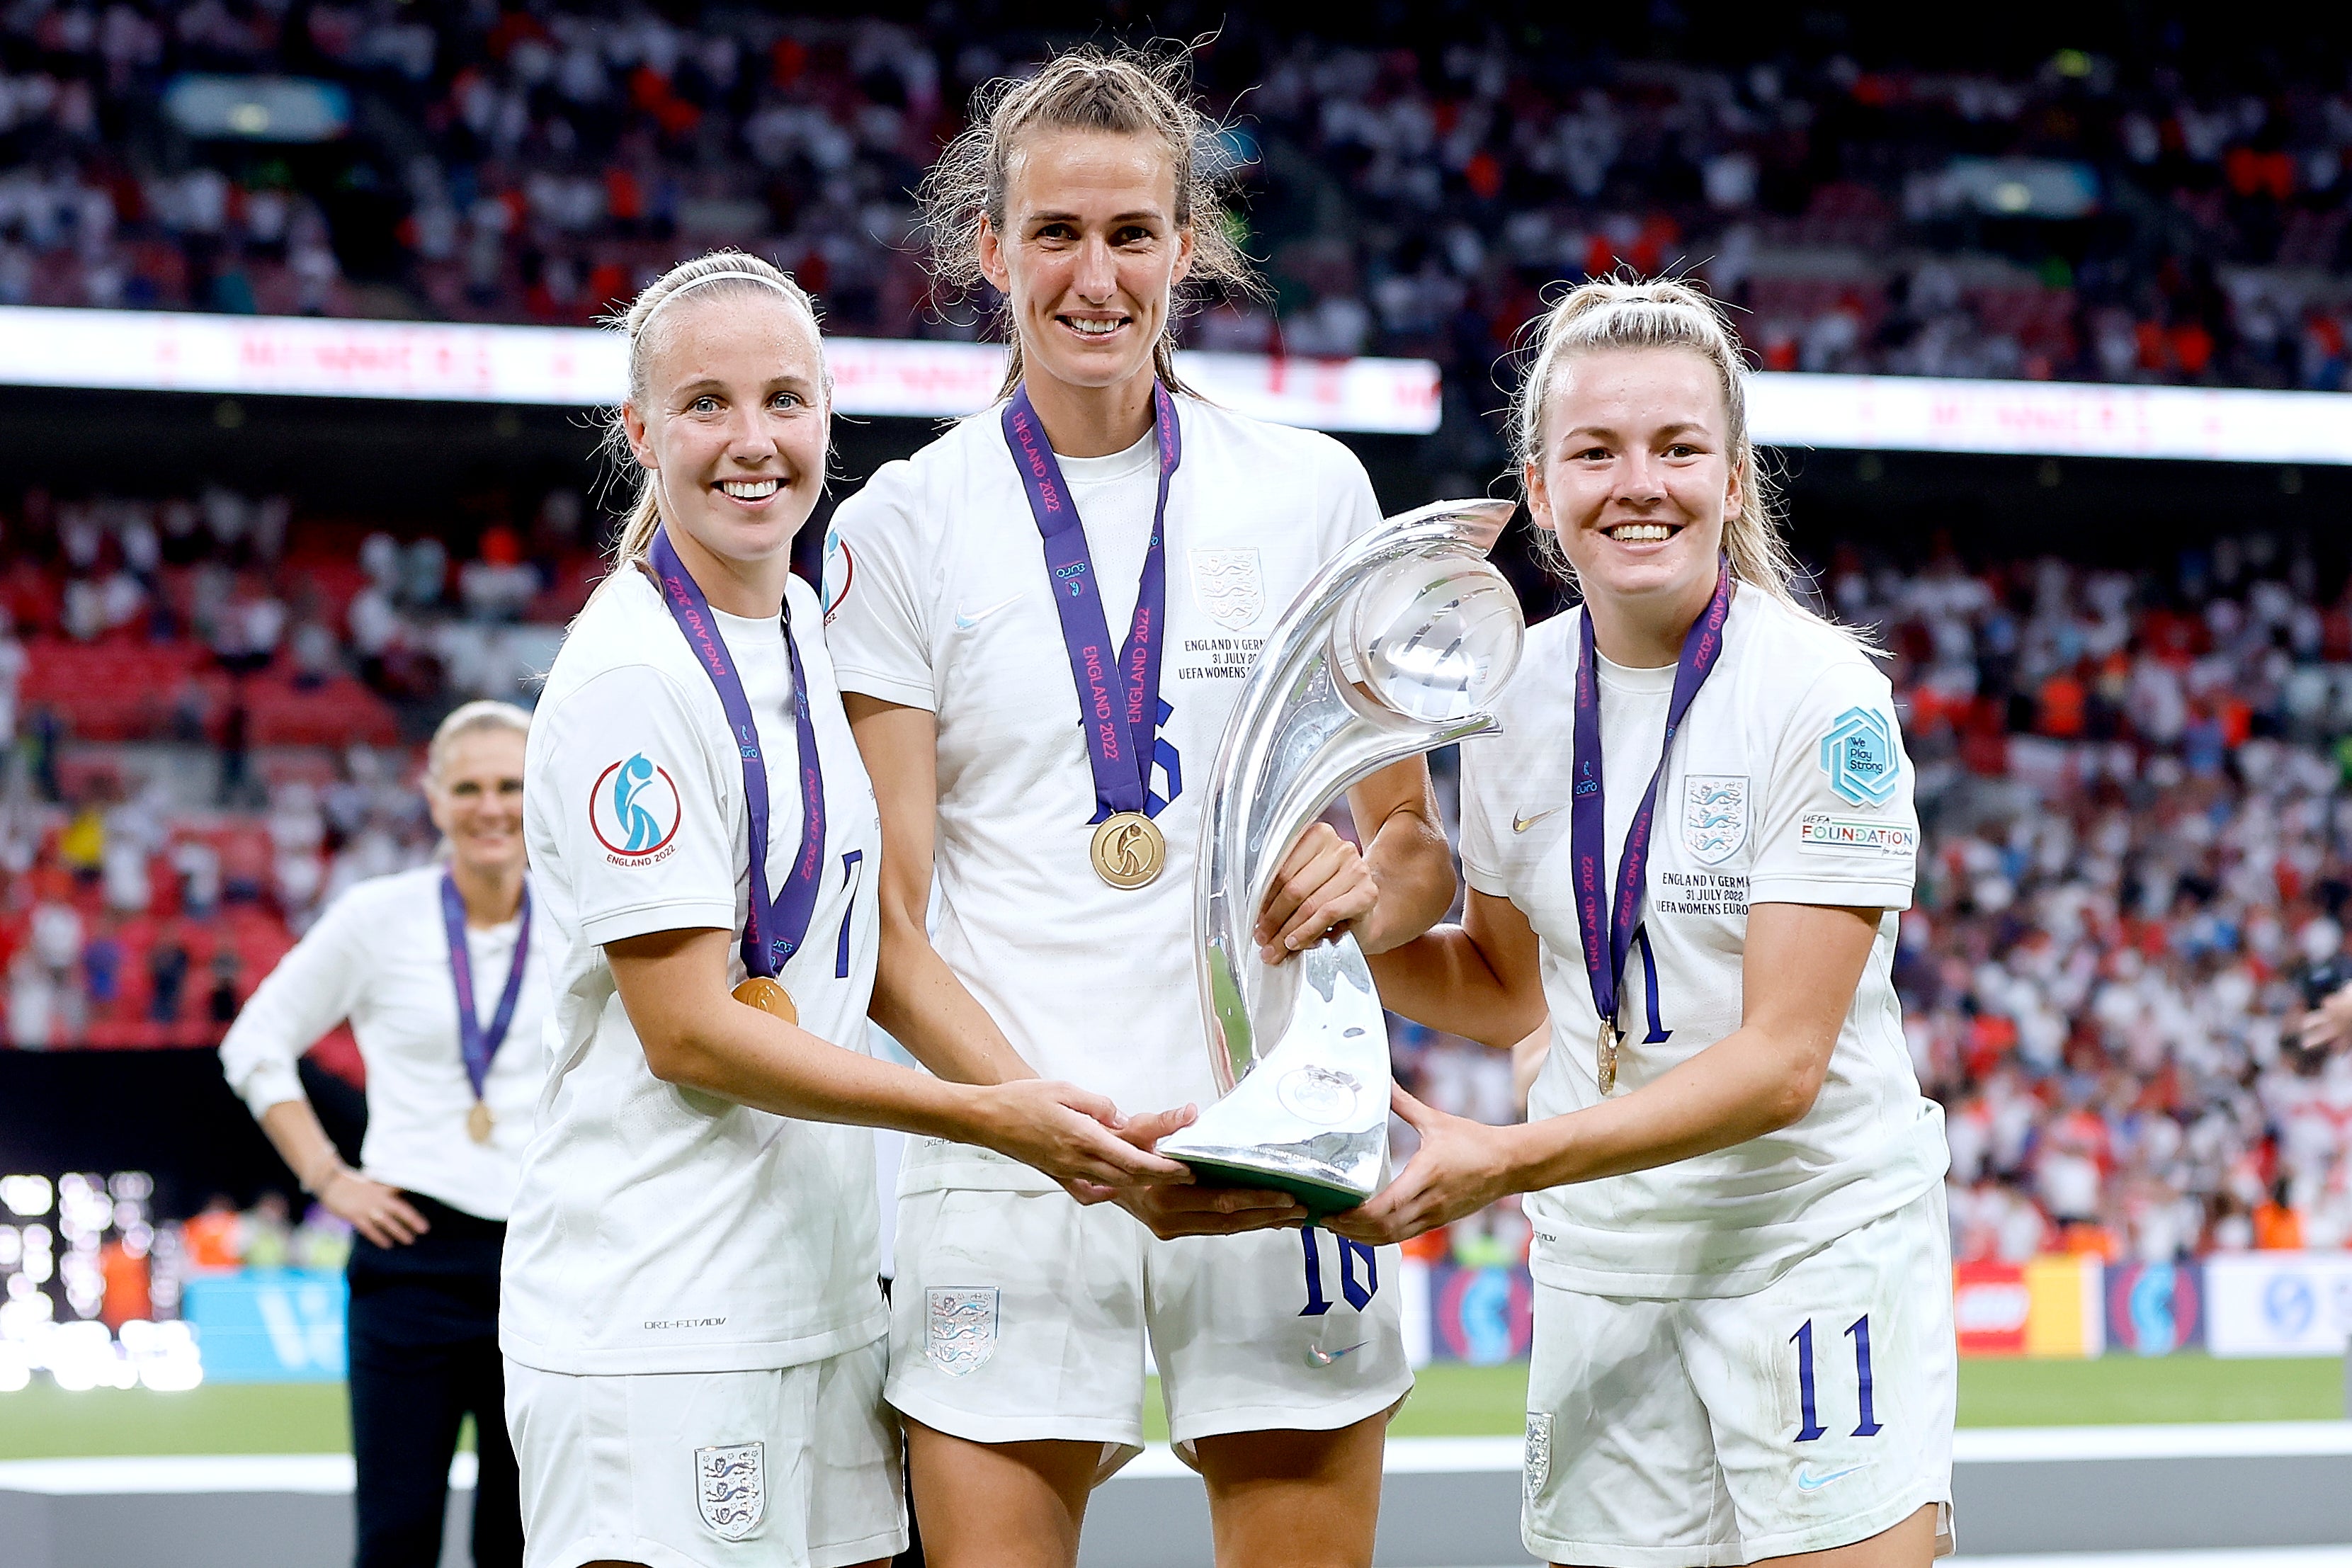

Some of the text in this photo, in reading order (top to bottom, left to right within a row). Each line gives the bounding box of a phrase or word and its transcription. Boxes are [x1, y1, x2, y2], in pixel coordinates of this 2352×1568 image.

[1012, 411, 1062, 513] ENGLAND 2022
[666, 576, 727, 676] ENGLAND 2022
[1184, 639, 1231, 652] ENGLAND
[1234, 639, 1239, 650] V
[1693, 632, 1715, 669] 2022
[1127, 607, 1151, 723] ENGLAND 2022
[1212, 653, 1221, 664] 31
[1224, 653, 1246, 664] JULY
[1178, 667, 1203, 679] UEFA
[1205, 666, 1246, 678] WOMENS
[1083, 645, 1120, 762] ENGLAND 2022
[1850, 737, 1865, 747] We
[1850, 749, 1872, 761] Play
[1850, 760, 1883, 775] Strong
[801, 768, 821, 882] ENGLAND 2022
[1802, 814, 1830, 824] UEFA
[606, 844, 676, 867] ENGLAND 2022
[1620, 812, 1647, 927] ENGLAND 2022
[1662, 873, 1707, 887] ENGLAND
[1709, 875, 1715, 886] V
[1686, 889, 1744, 902] 31 JULY 2022
[836, 849, 863, 979] 7
[1581, 853, 1599, 970] ENGLAND 2022
[1656, 900, 1748, 915] UEFA WOMENS EURO
[1789, 1312, 1884, 1443] 11
